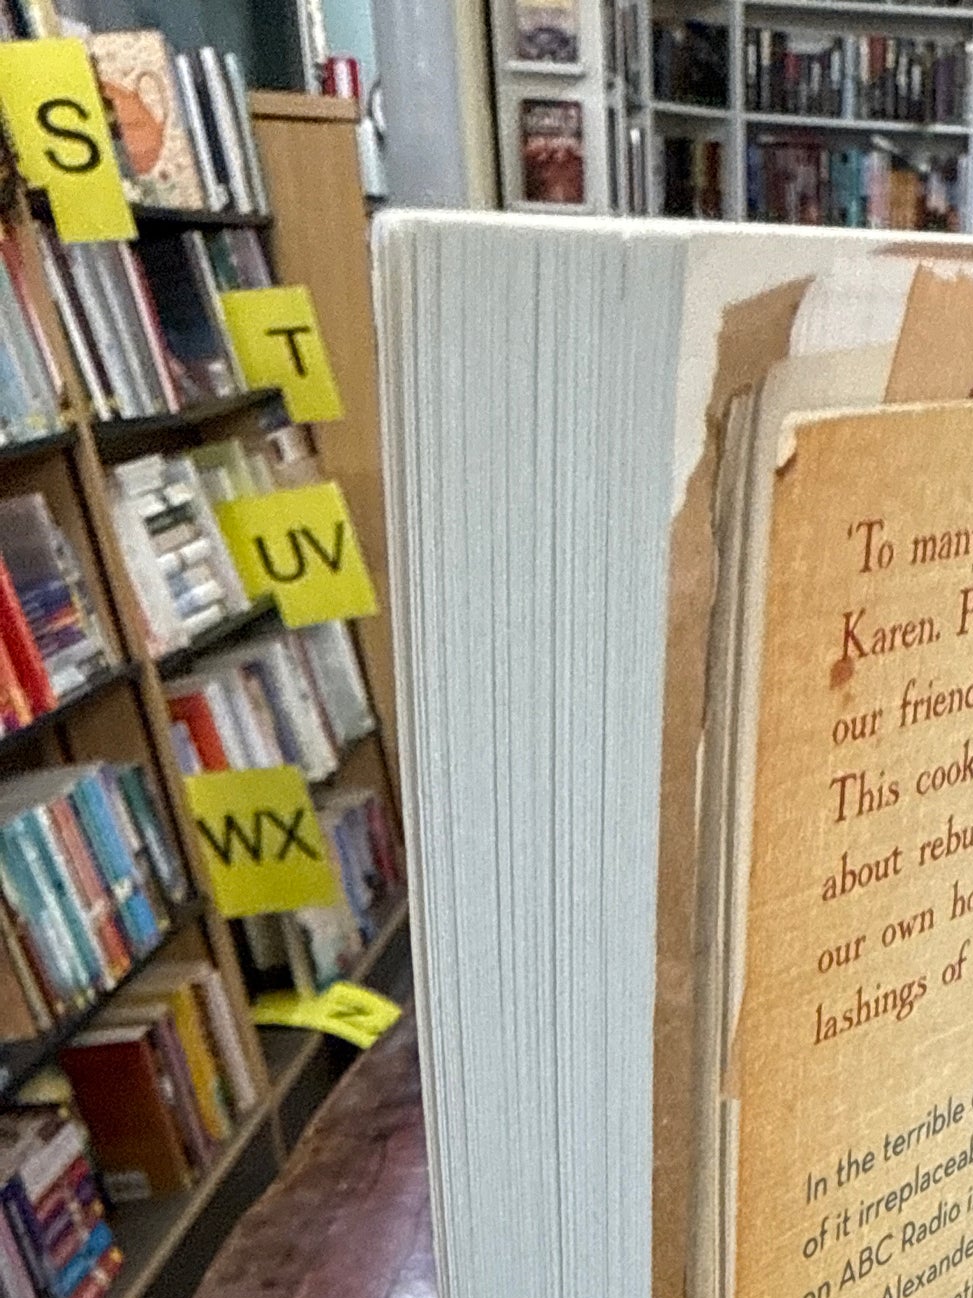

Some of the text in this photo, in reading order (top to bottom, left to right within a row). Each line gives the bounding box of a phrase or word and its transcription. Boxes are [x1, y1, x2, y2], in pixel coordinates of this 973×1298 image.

[35, 99, 102, 173] S
[266, 324, 311, 378] T
[255, 519, 345, 583] UV
[838, 609, 939, 662] Karen.
[831, 700, 883, 743] our
[828, 765, 900, 825] This
[196, 808, 323, 867] WX
[821, 835, 902, 902] about
[817, 928, 865, 974] our
[881, 901, 935, 948] own
[814, 969, 928, 1045] lashings
[941, 937, 969, 988] of
[805, 1168, 828, 1203] In
[836, 1141, 875, 1186] the
[882, 1092, 965, 1161] terrible
[802, 1212, 829, 1259] of
[835, 1204, 850, 1240] it
[839, 1230, 893, 1290] ABC
[900, 1197, 961, 1252] Radio
